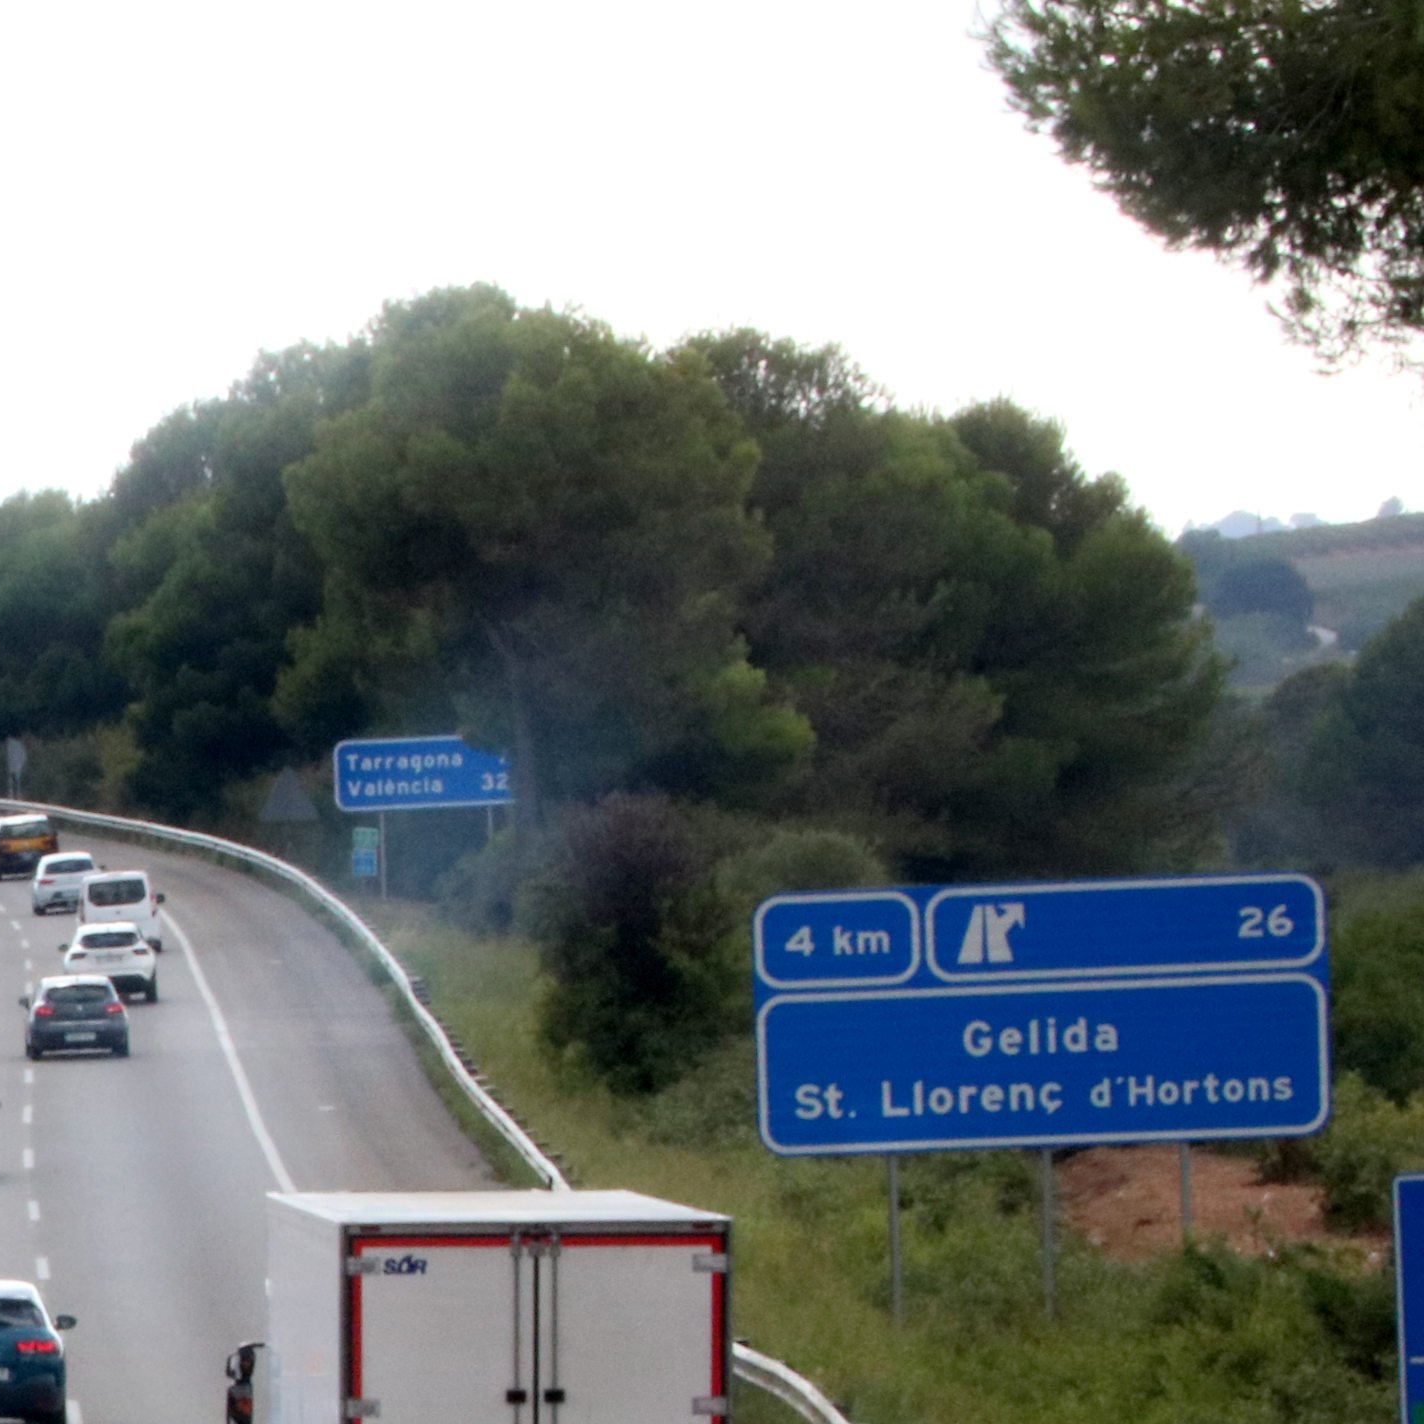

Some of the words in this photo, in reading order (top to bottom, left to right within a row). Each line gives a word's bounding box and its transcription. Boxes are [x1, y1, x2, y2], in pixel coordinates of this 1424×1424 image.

[345, 751, 463, 773] Tarragona
[1237, 904, 1293, 939] 26
[784, 924, 814, 957] 4
[832, 925, 890, 957] km
[962, 1017, 1119, 1057] Gelida
[794, 1083, 857, 1120] St.
[881, 1079, 1063, 1116] Llorenç
